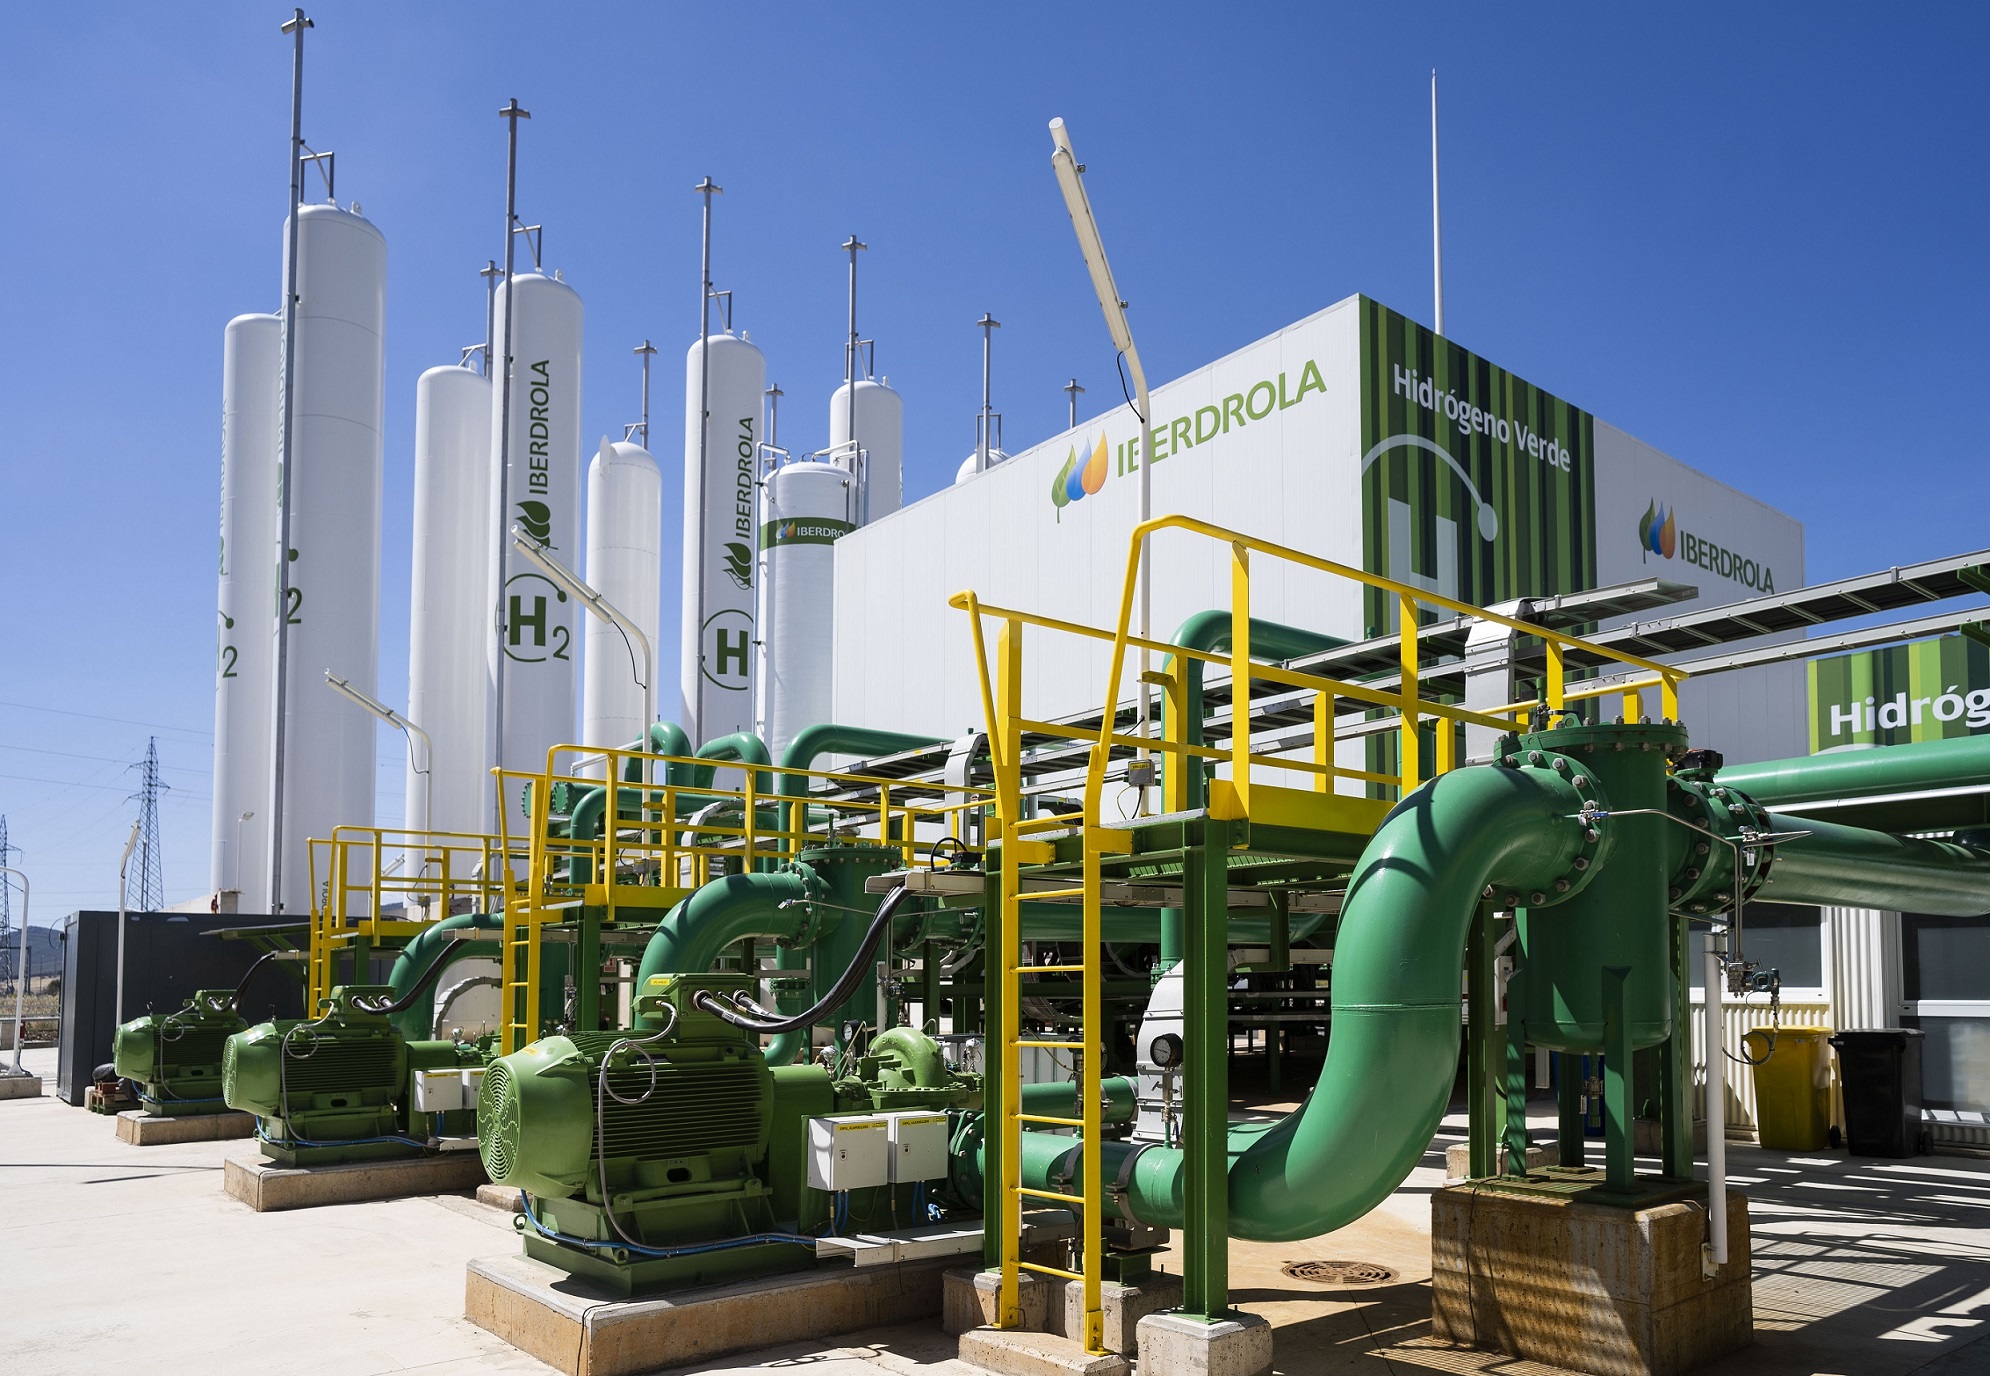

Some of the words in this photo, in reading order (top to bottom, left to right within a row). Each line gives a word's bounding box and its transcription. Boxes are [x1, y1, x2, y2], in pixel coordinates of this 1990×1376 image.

[529, 360, 549, 494] IBERDROLA
[1118, 359, 1327, 478] IBERDROLA
[1394, 363, 1510, 443] Hidrógeno
[1514, 420, 1571, 472] Verde
[736, 417, 753, 539] IBERDROLA
[797, 526, 845, 538] IBERDRO
[1680, 530, 1775, 595] IBERDROLA
[1830, 685, 1990, 736] Hidróg
